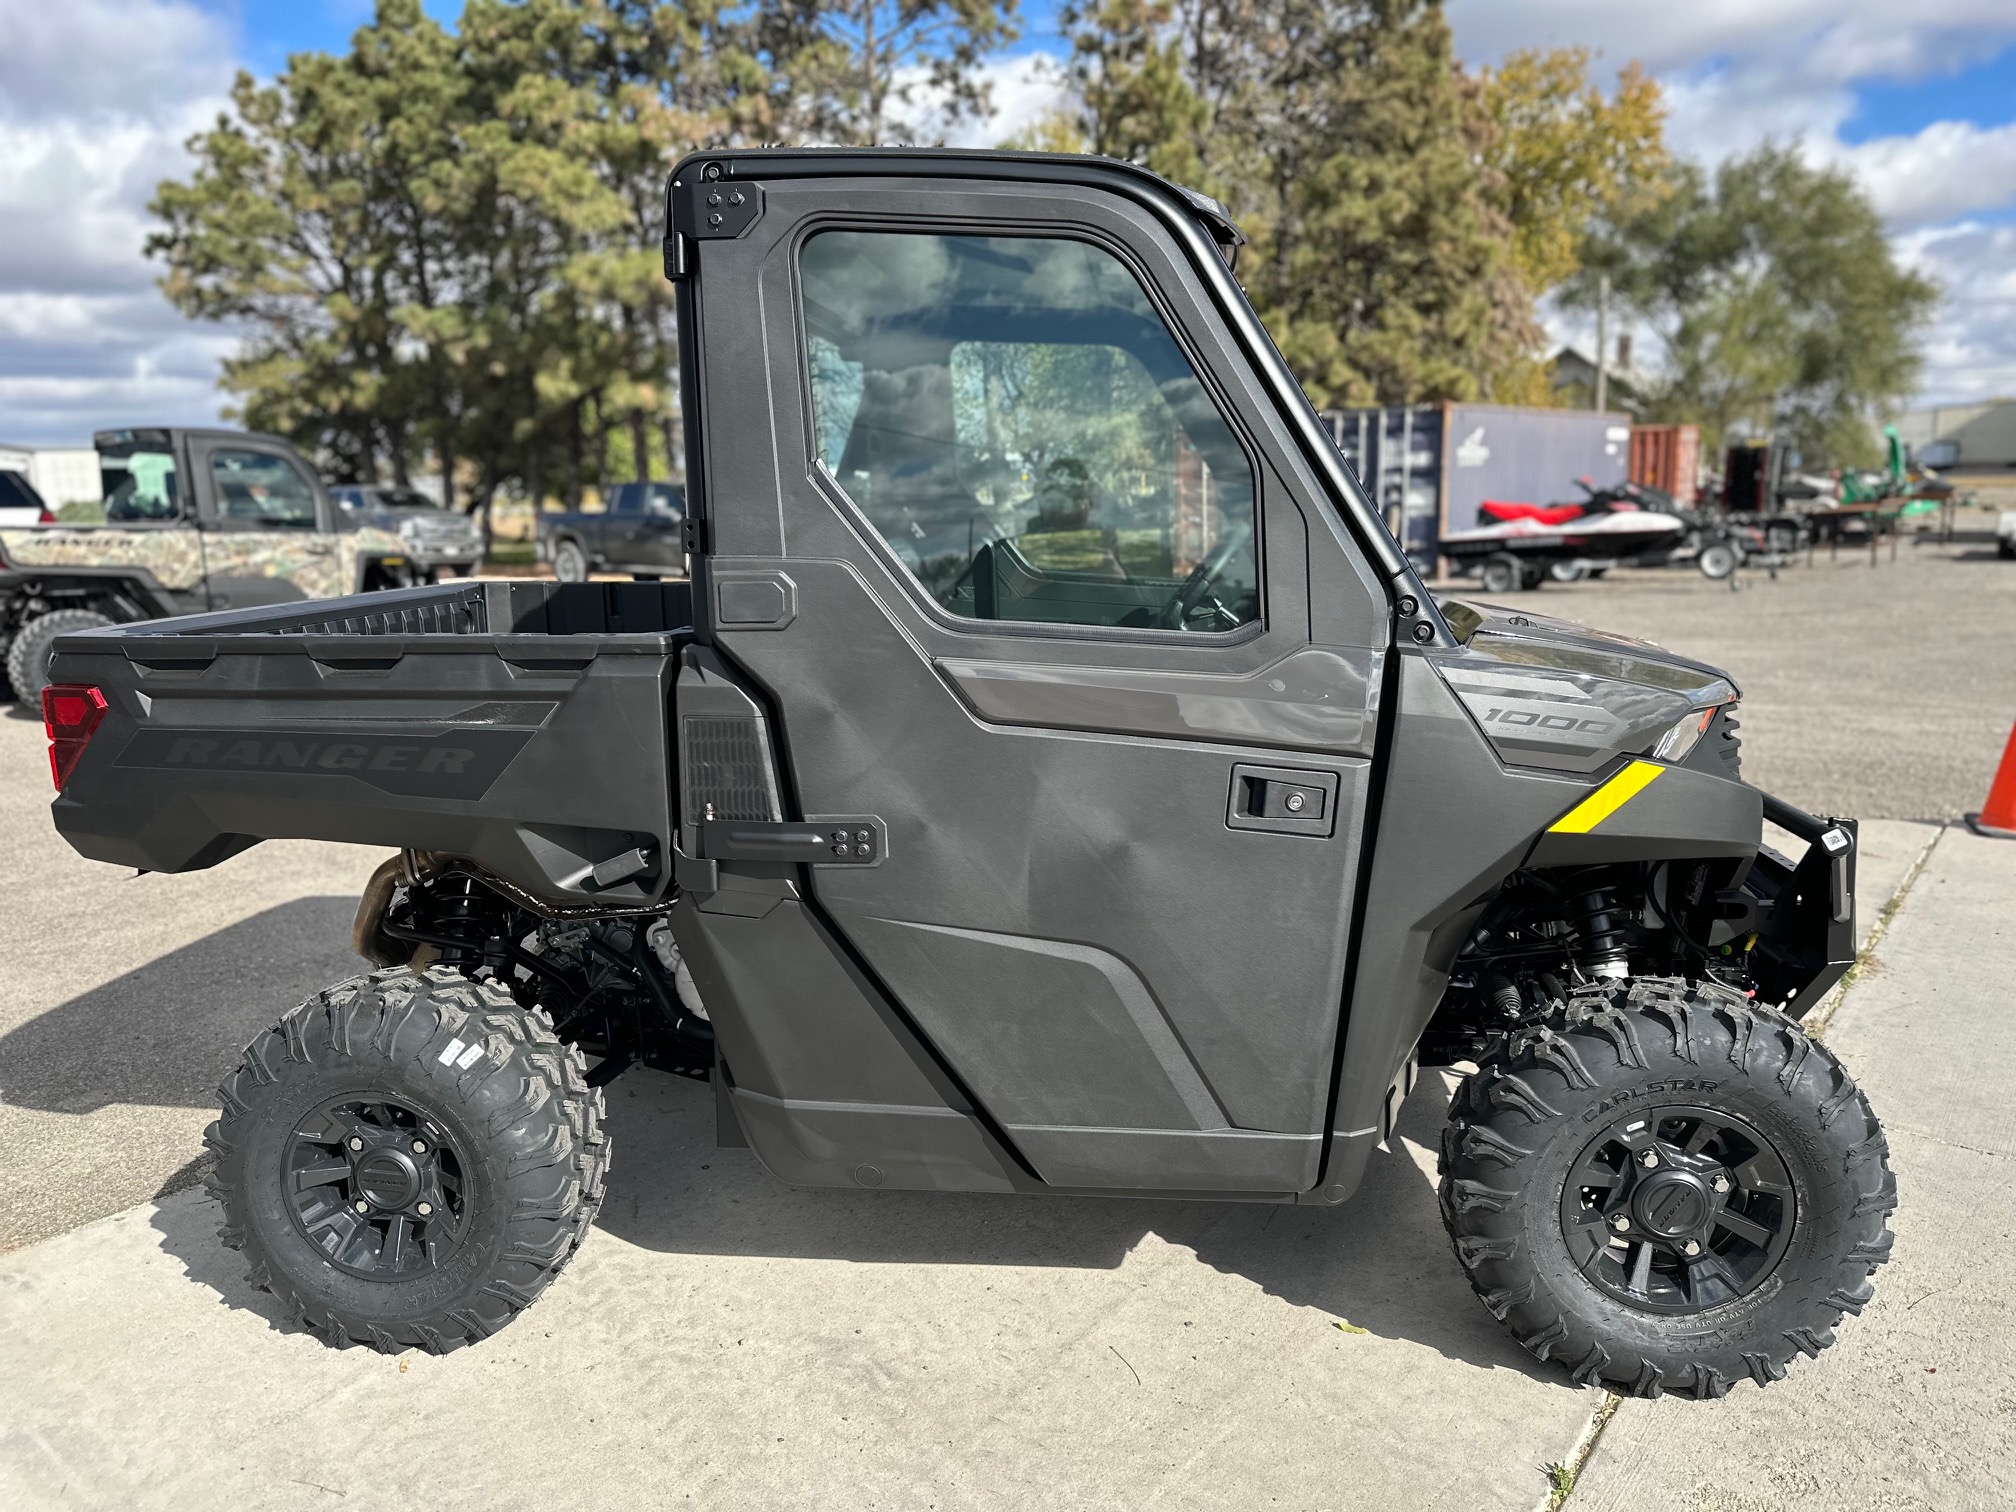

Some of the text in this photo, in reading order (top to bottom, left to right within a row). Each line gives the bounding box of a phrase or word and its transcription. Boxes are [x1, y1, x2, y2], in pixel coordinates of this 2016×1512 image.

[1484, 708, 1616, 735] 1000
[163, 738, 476, 774] RANGER
[1581, 1078, 1718, 1124] CARLSTAR
